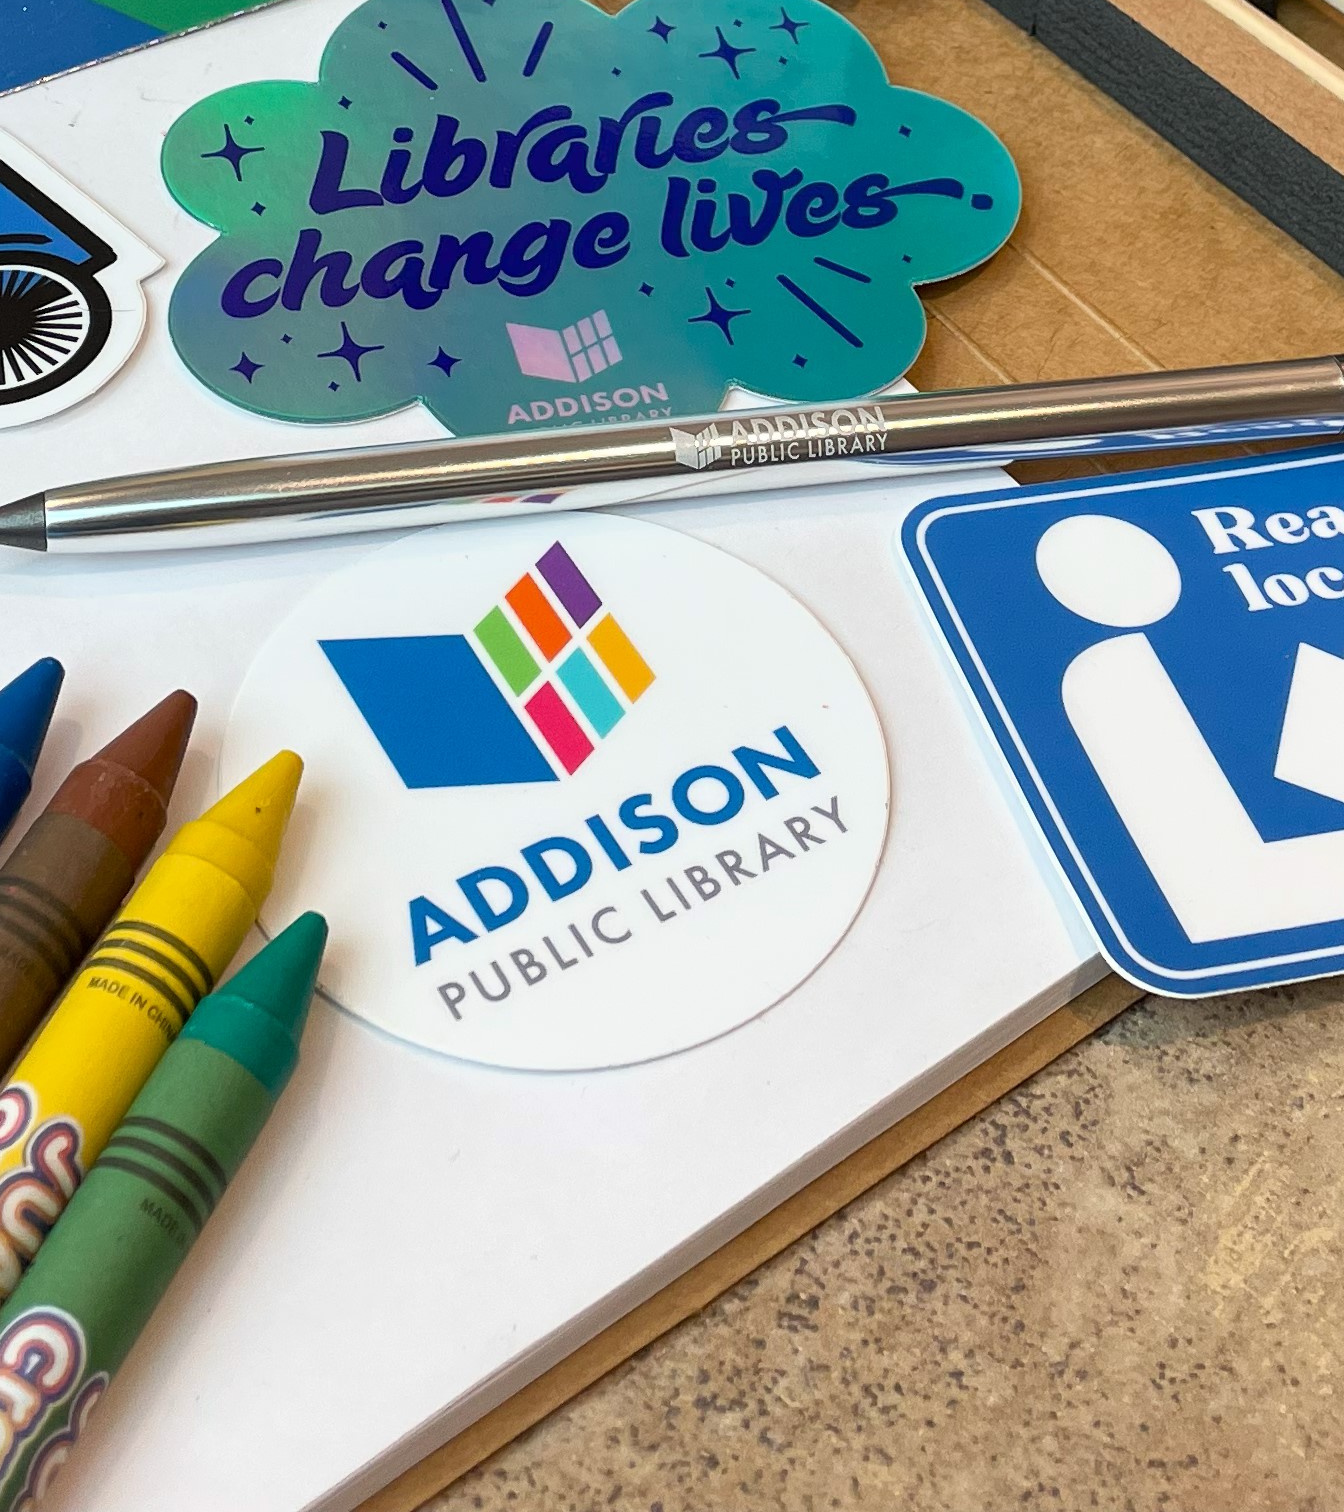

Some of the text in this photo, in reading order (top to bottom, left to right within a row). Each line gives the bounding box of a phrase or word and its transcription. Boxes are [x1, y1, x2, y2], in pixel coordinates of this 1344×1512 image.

[308, 91, 856, 215] Libraries
[220, 210, 630, 319] change
[508, 383, 669, 425] ADDISON
[731, 406, 887, 440] ADDISON
[732, 431, 888, 467] PUBLIC LIBRARY
[409, 725, 821, 966] ADDISON
[437, 796, 848, 1021] PUBLIC LIBRARY
[87, 977, 178, 1042] MADE IN CHIN
